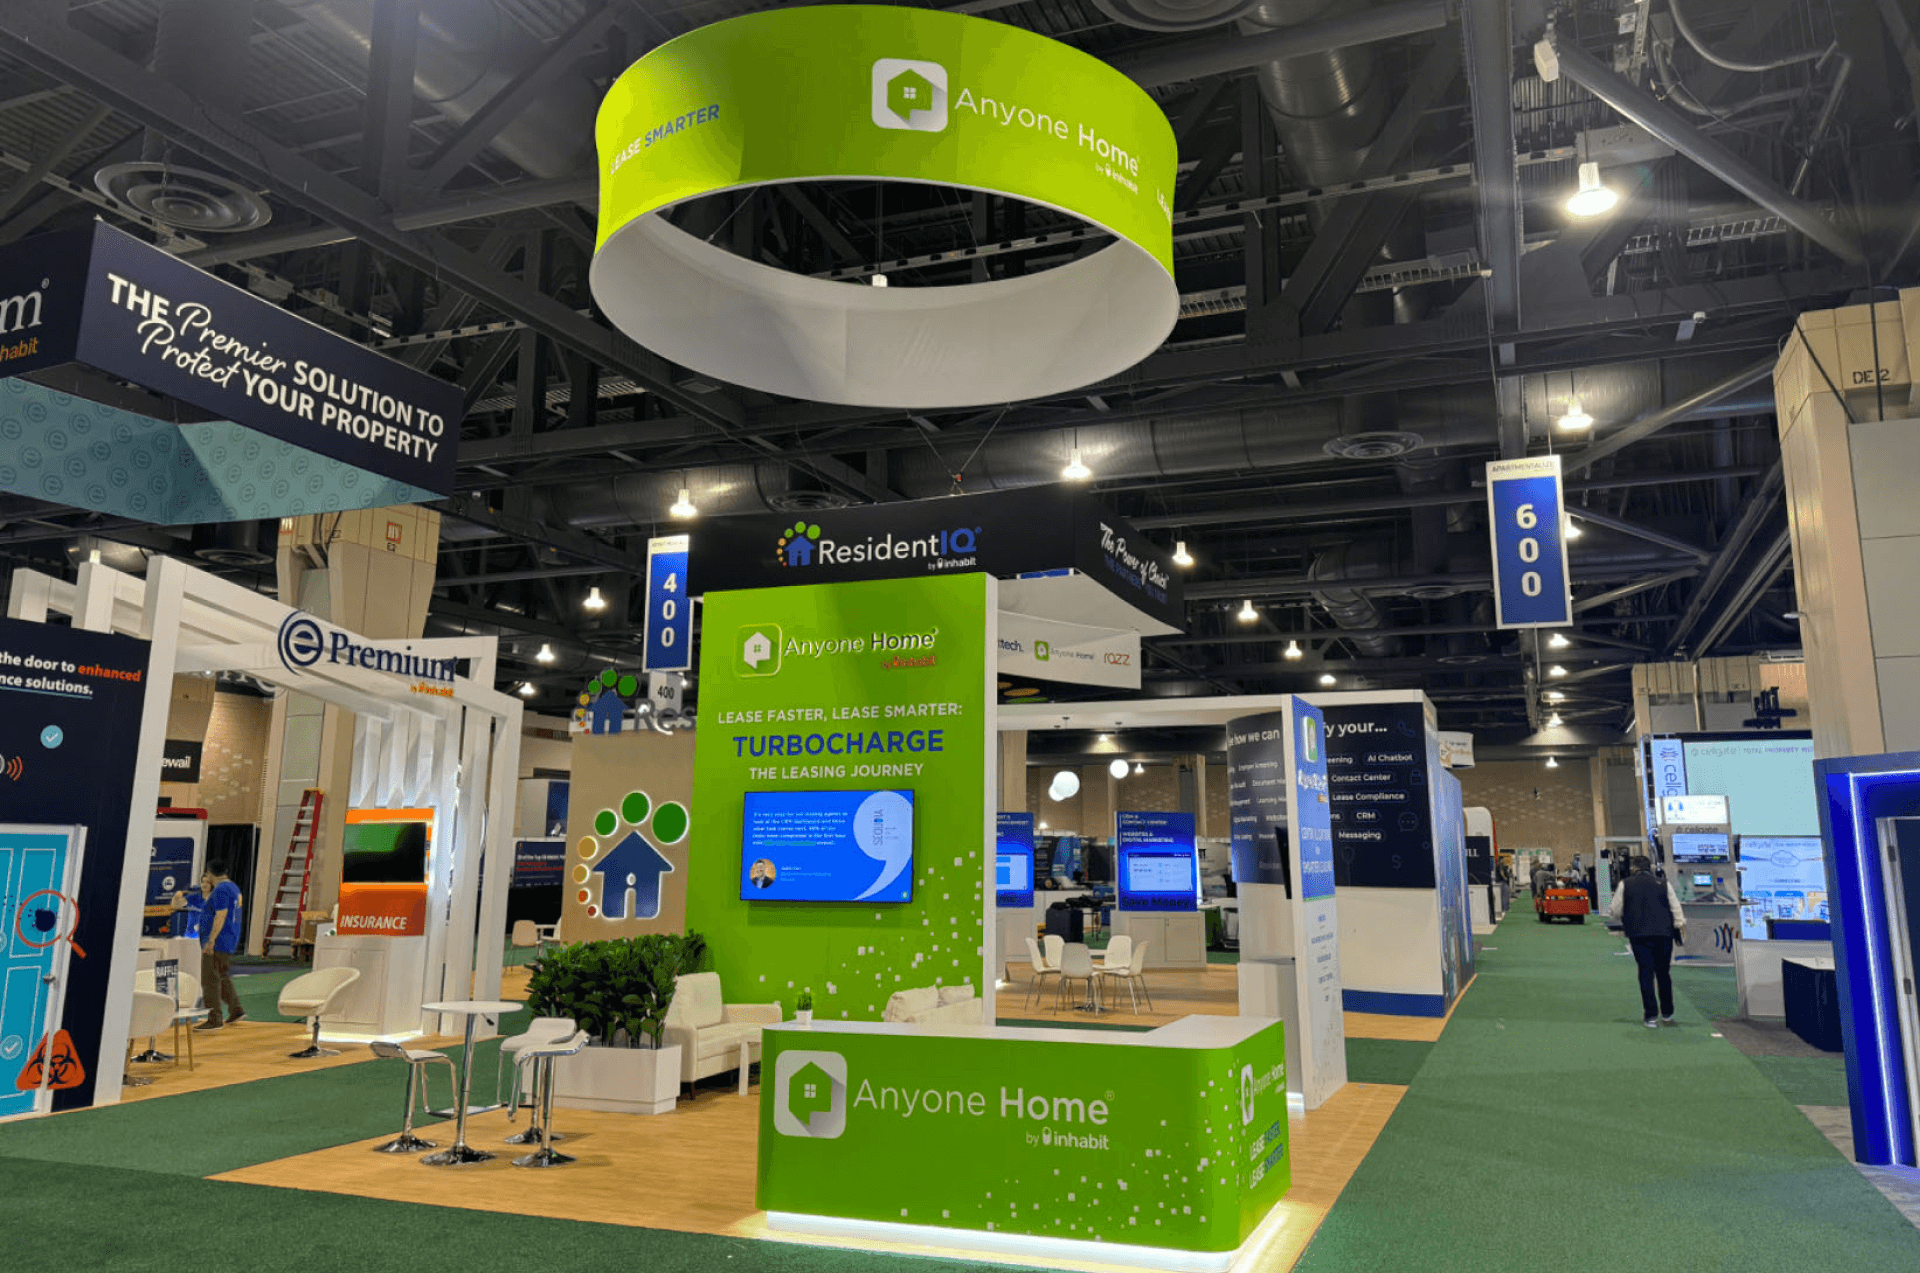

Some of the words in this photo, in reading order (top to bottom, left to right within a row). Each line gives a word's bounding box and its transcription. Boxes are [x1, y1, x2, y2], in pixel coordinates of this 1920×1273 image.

[644, 104, 720, 148] SMARTER
[954, 88, 1069, 139] Anyone
[1079, 123, 1139, 177] Home
[107, 273, 170, 325] THE
[175, 302, 287, 373] Premier
[293, 360, 412, 427] SOLUTION
[416, 407, 444, 437] TO
[137, 319, 242, 388] Protect
[243, 368, 315, 421] YOUR
[321, 402, 438, 463] PROPERTY
[1515, 503, 1542, 597] 600
[660, 572, 678, 648] 400
[784, 636, 865, 659] Anyone
[871, 632, 937, 651] Home
[24, 654, 59, 671] door
[61, 660, 76, 673] to
[77, 663, 142, 682] enhanced
[25, 676, 94, 695] solutions.
[657, 685, 675, 700] 400
[718, 710, 763, 725] LEASE
[767, 708, 828, 723] FASTER,
[832, 705, 880, 721] LEASE
[884, 702, 963, 718] SMARTER:
[1261, 729, 1280, 741] can
[1337, 722, 1388, 738] your...
[732, 729, 945, 758] TURBOCHARGE
[1377, 753, 1413, 762] Chatbot
[749, 766, 777, 780] THE
[781, 765, 846, 779] LEASING
[851, 763, 924, 778] JOURNEY
[1331, 774, 1362, 783] Contact
[1362, 773, 1391, 782] Center
[1332, 793, 1354, 802] Lease
[1355, 792, 1405, 802] Compliance
[1356, 811, 1376, 820] CRM
[1338, 831, 1382, 841] Messaging
[339, 914, 408, 931] INSURANCE
[853, 1078, 986, 1119] Anyone
[1025, 1131, 1039, 1147] by
[1053, 1131, 1110, 1151] inhabit
